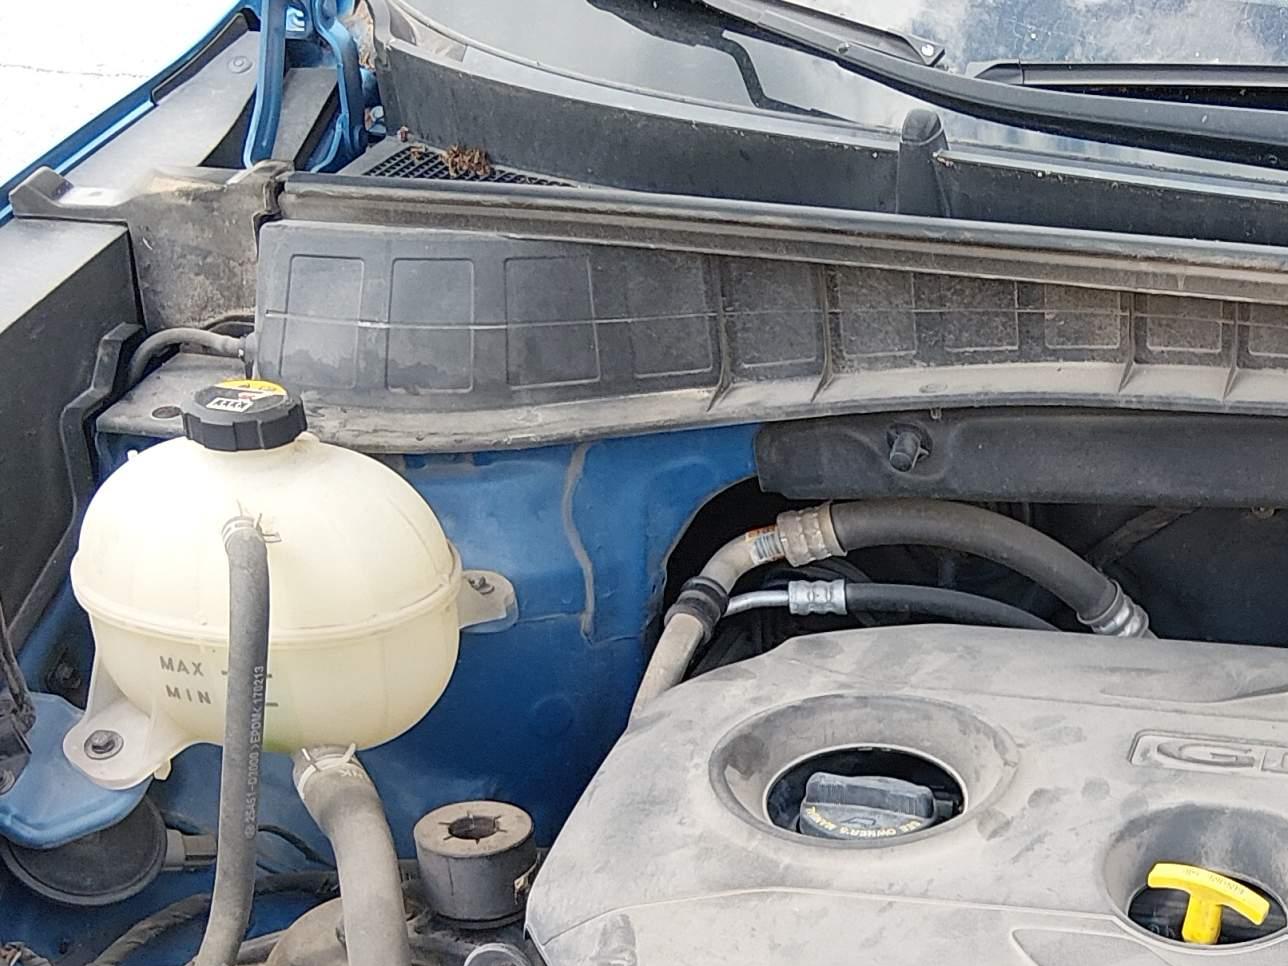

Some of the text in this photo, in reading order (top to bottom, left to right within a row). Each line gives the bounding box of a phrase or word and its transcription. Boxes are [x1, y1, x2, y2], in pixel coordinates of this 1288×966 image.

[159, 655, 204, 677] MAX
[165, 684, 212, 704] MIN
[252, 665, 265, 704] 170213
[839, 827, 897, 837] OWNER'S
[899, 820, 921, 832] SEE
